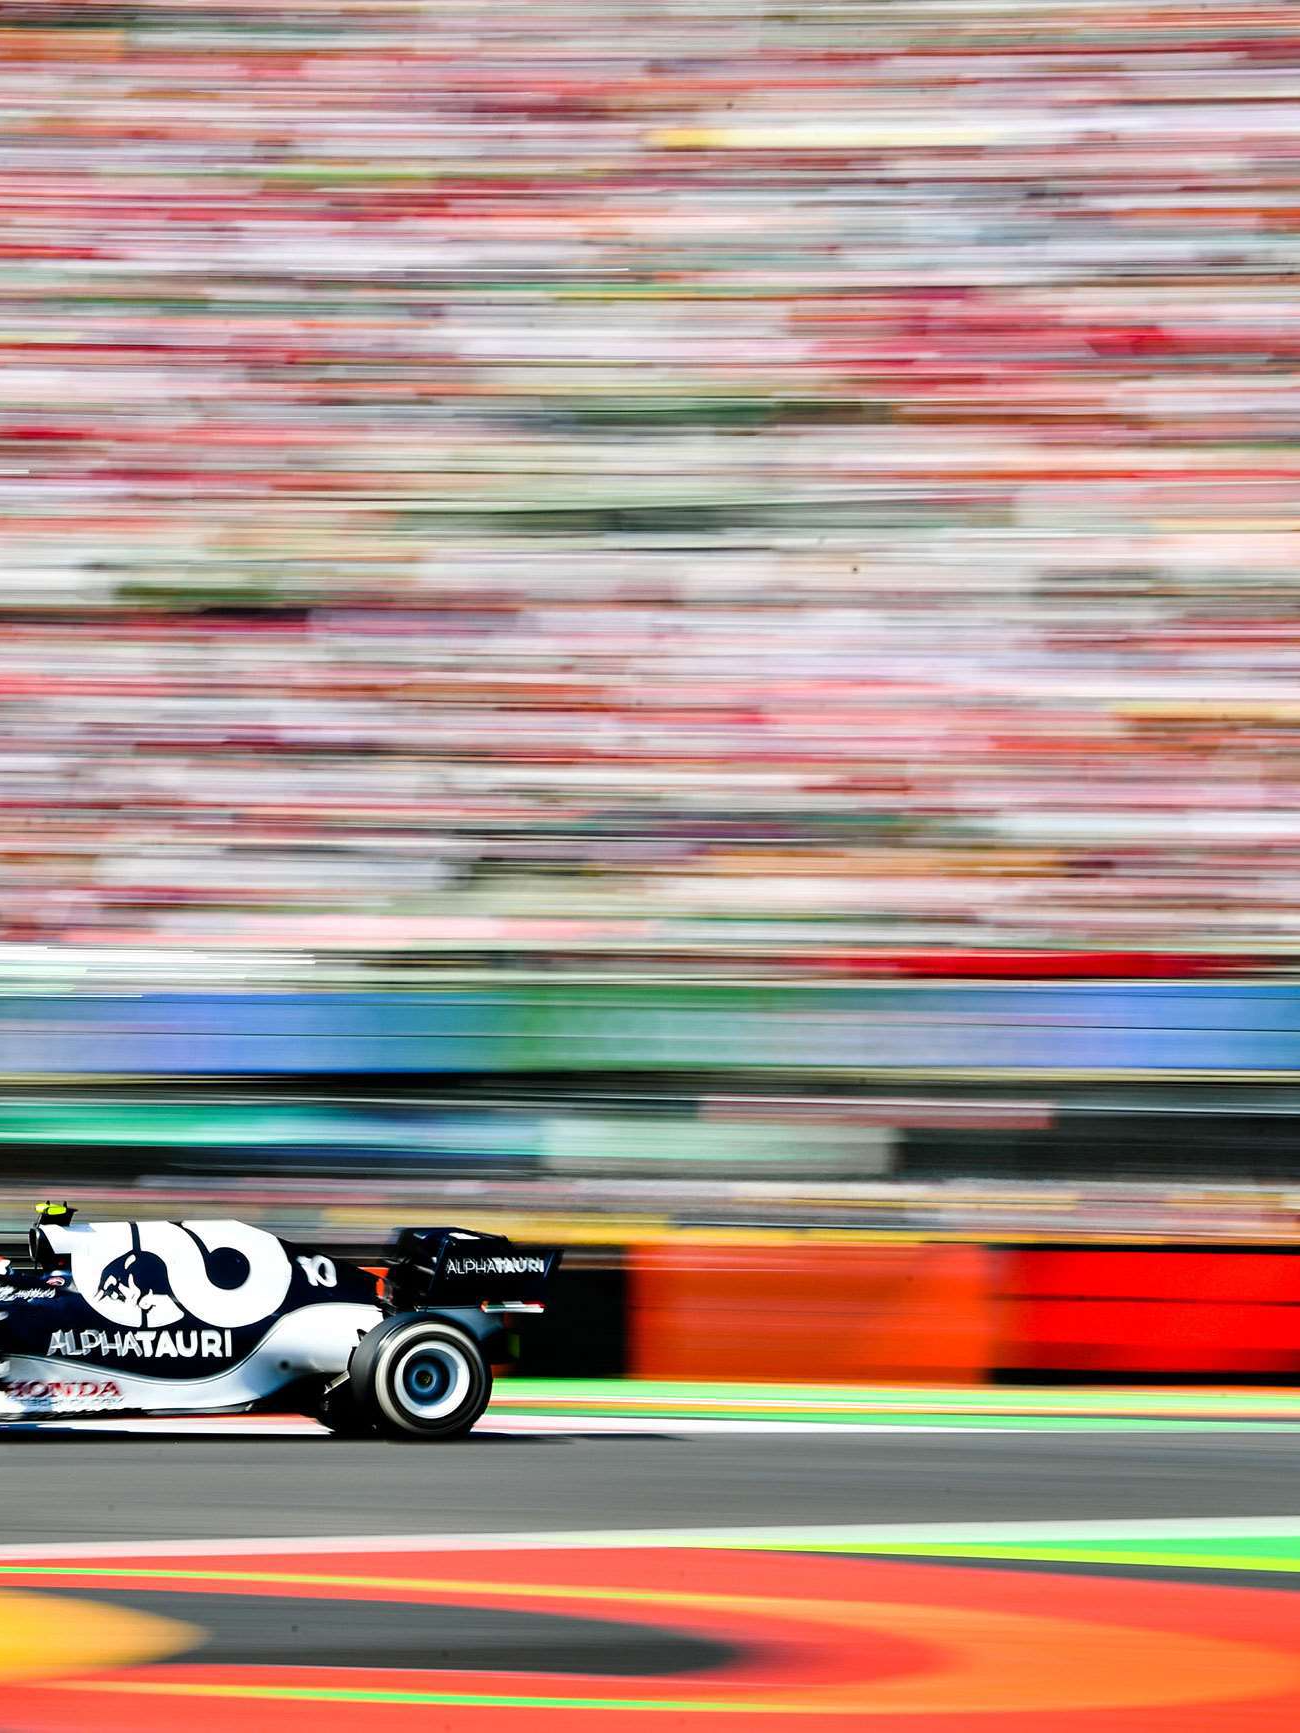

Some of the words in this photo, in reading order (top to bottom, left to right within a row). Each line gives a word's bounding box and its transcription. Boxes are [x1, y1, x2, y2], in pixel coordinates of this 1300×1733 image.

[447, 1256, 545, 1275] ALPHATAURI
[46, 1329, 233, 1358] ALPHATAURI
[5, 1381, 122, 1398] HONDA
